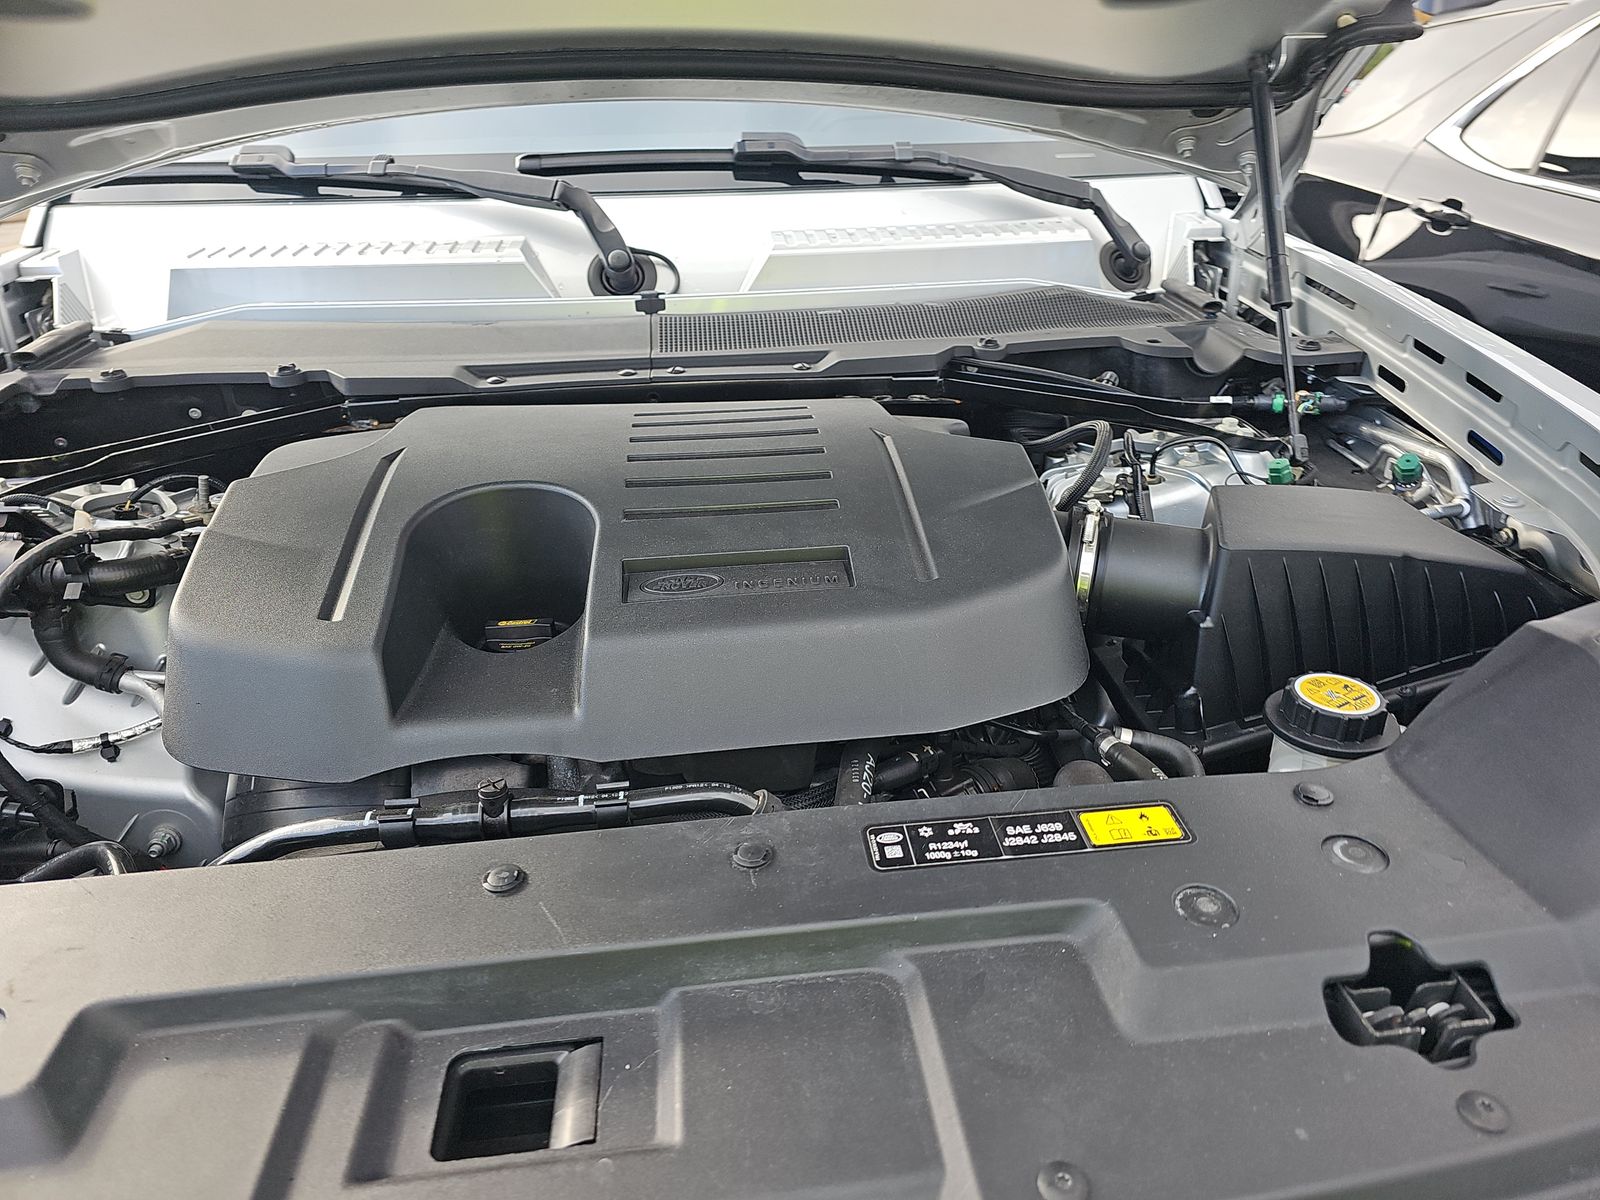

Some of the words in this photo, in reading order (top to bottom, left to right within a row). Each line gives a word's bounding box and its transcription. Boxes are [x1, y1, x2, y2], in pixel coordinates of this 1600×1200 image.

[733, 575, 840, 590] INGENIUM
[858, 752, 876, 805] AJ20-
[1005, 824, 1033, 836] SAE
[1034, 822, 1064, 833] J639
[928, 839, 969, 851] R1234yf
[1002, 834, 1039, 847] J2842
[1040, 831, 1078, 844] J2845
[924, 850, 952, 860] 1000g
[952, 849, 979, 857] ±10g
